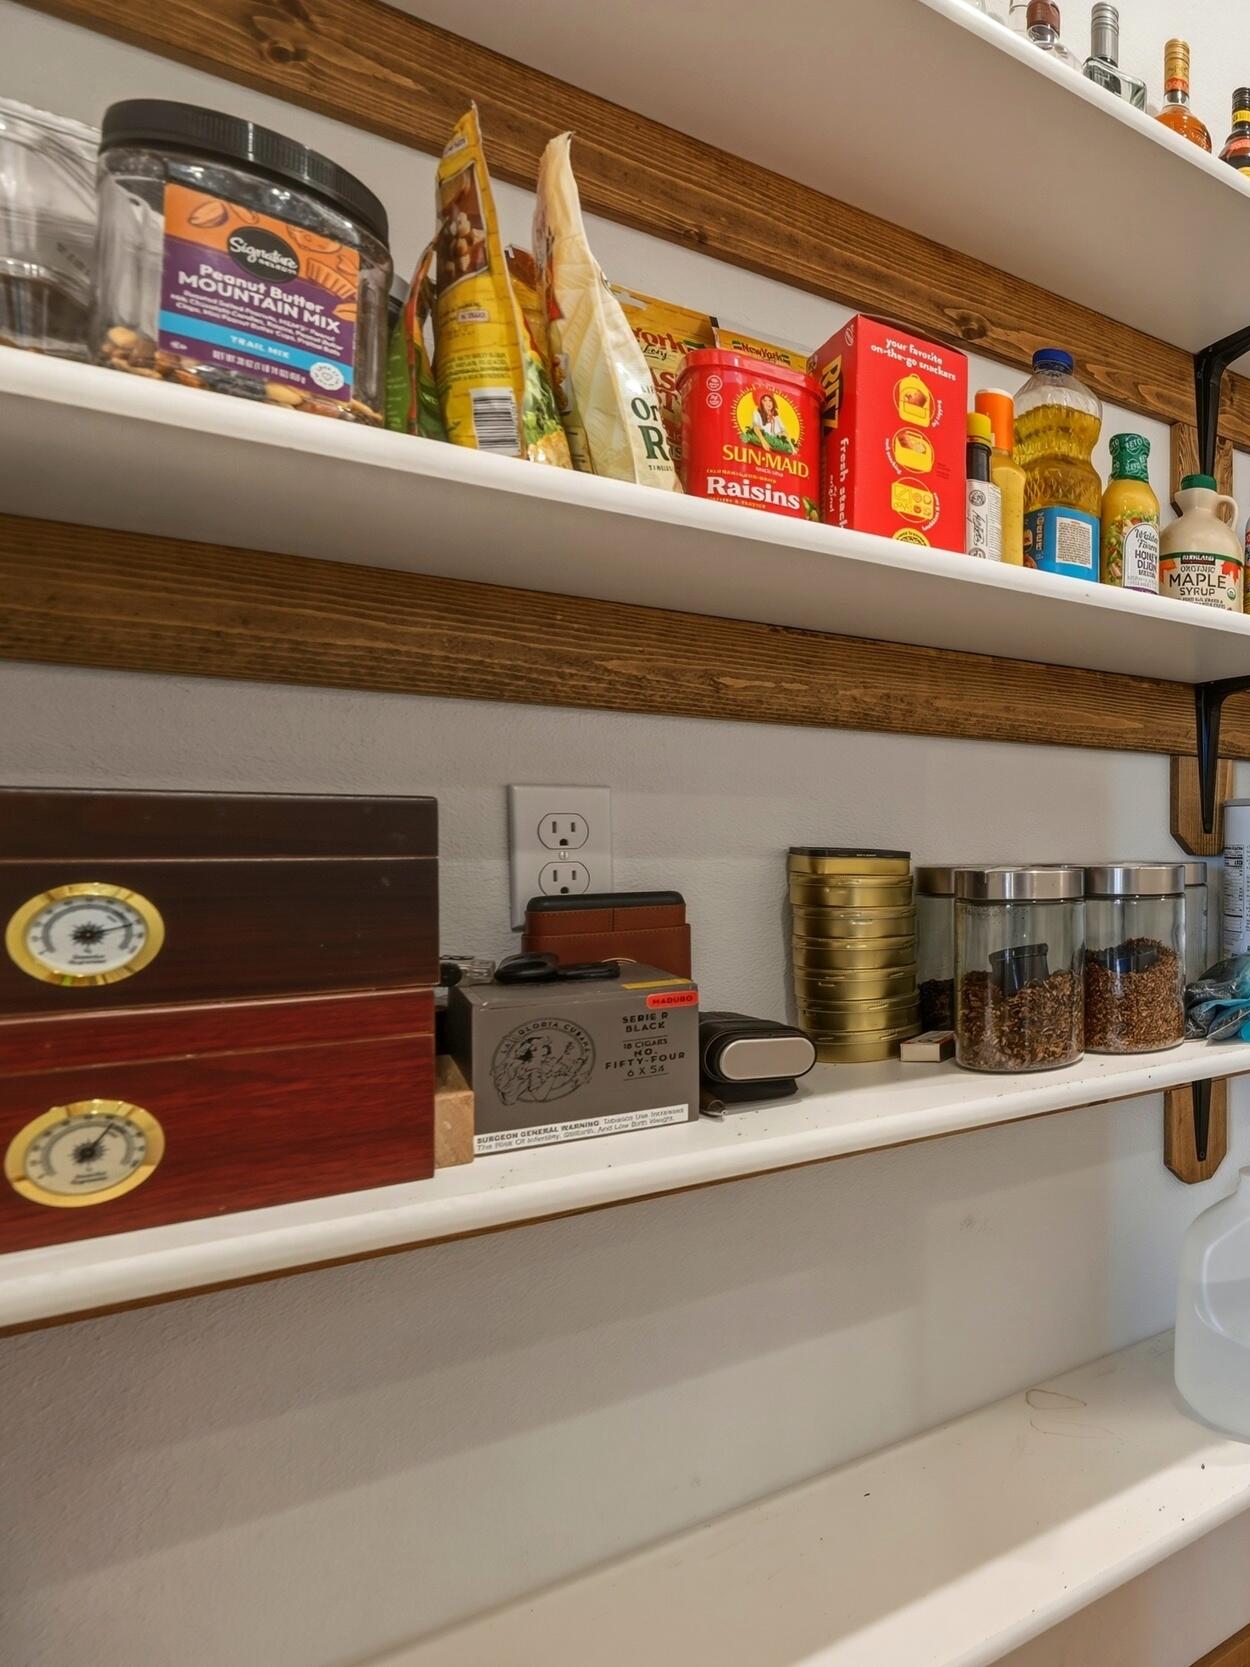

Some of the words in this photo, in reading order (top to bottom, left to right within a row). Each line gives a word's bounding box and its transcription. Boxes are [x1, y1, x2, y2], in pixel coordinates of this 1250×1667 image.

[229, 236, 298, 269] Signature
[199, 264, 267, 294] Peanut
[269, 286, 325, 313] Butter
[178, 271, 298, 319] MOUNTAIN
[303, 309, 341, 334] MIX
[229, 335, 265, 352] TRAIL
[267, 347, 291, 359] MIX
[886, 337, 907, 351] your
[909, 341, 943, 365] favorite
[870, 344, 917, 367] on-the-go
[919, 359, 957, 381] snackers
[839, 437, 849, 483] fresh
[706, 476, 800, 510] Raisins
[1180, 565, 1216, 574] ORGANIC
[1169, 573, 1227, 590] MAPLE
[1180, 587, 1216, 597] SYRUP
[652, 995, 693, 1005] MADURO
[622, 1013, 657, 1024] SERIE
[661, 1012, 669, 1020] R
[625, 1021, 665, 1033] BLACK
[518, 1021, 559, 1036] GLORIA
[563, 1024, 590, 1053] CUBANA
[634, 1038, 668, 1049] CIGARS
[605, 1052, 686, 1070] FIFTY-FOUR
[634, 1048, 659, 1057] NO.
[627, 1069, 634, 1077] 6
[639, 1067, 646, 1075] X
[650, 1065, 665, 1074] 54
[477, 1133, 518, 1145] SURGEON
[520, 1127, 559, 1138] GENERAL
[561, 1120, 600, 1131] WARNING
